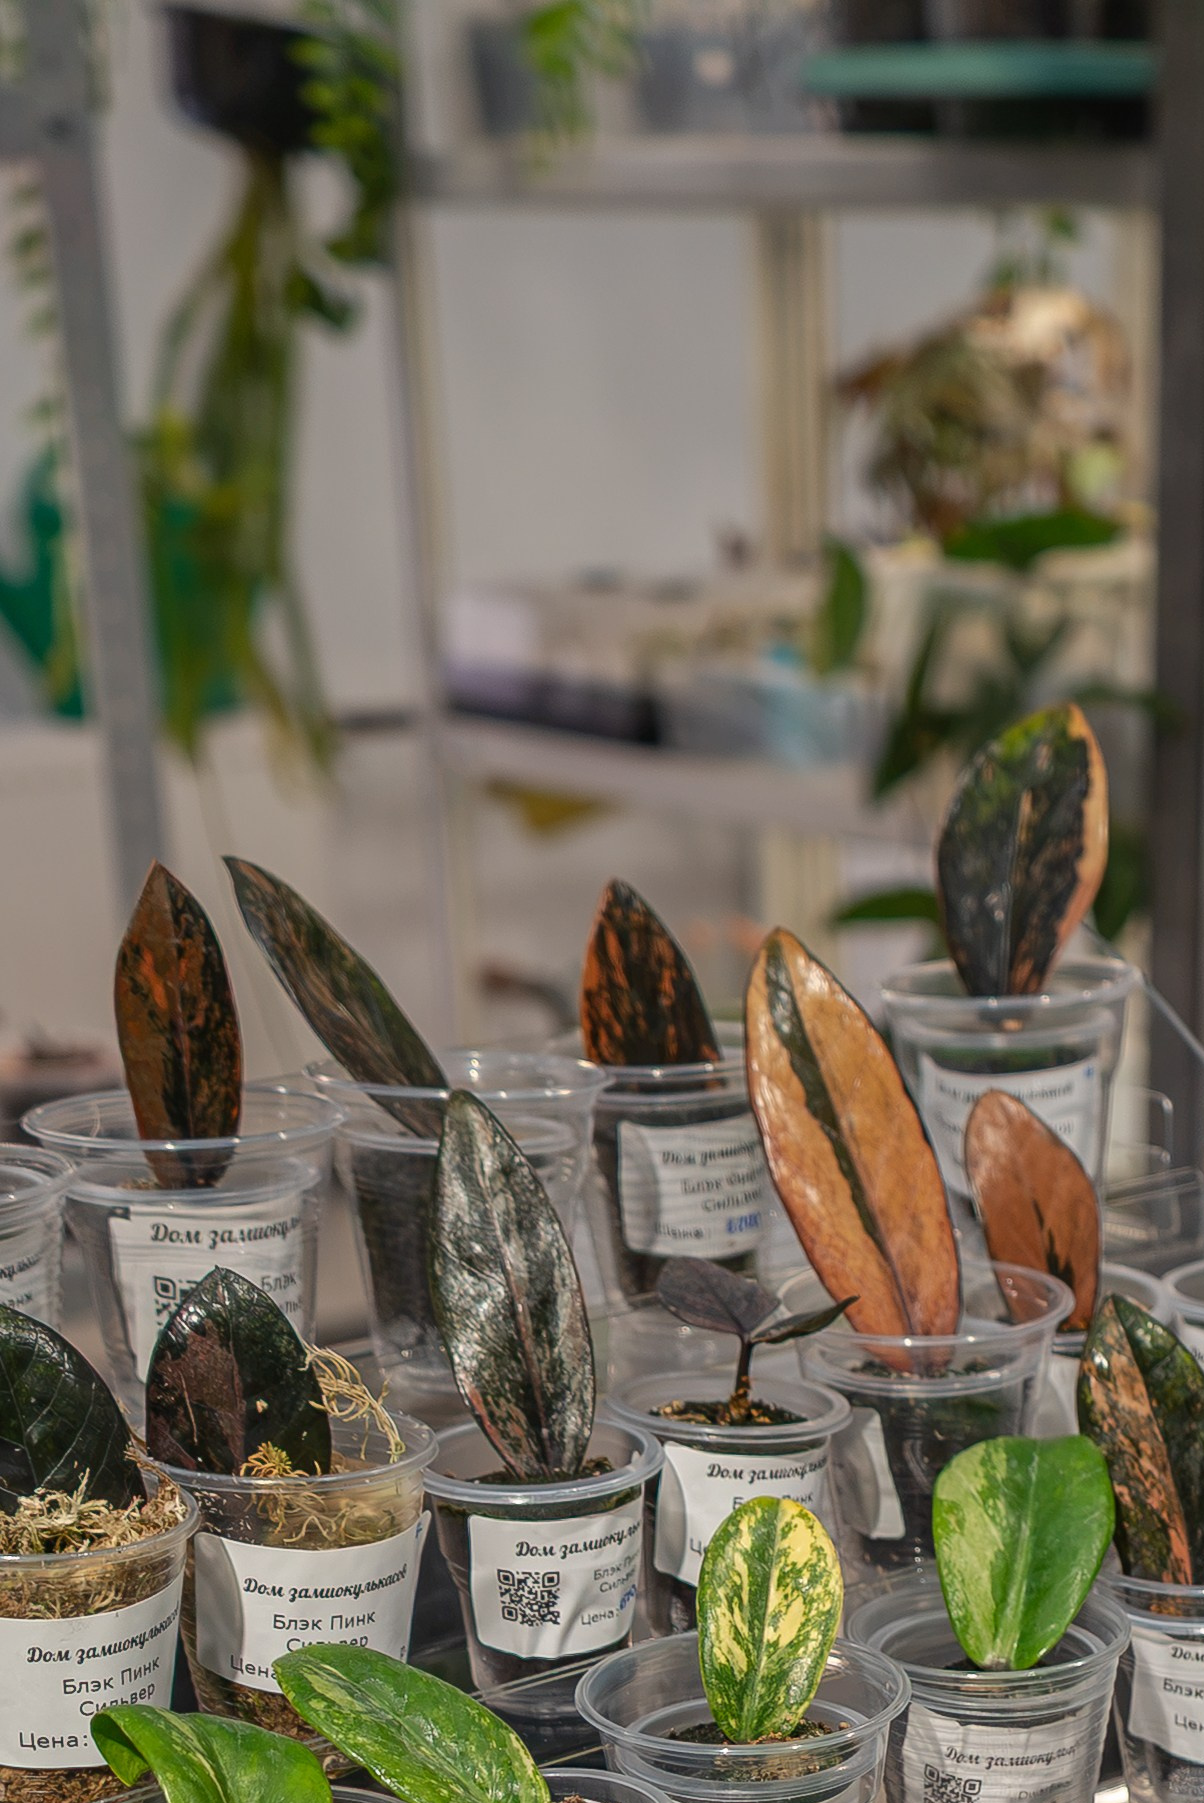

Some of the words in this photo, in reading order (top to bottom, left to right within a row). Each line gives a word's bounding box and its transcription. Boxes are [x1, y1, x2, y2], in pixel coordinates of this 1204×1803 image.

[151, 1223, 201, 1244] Дом
[707, 1463, 743, 1480] Дом
[516, 1541, 556, 1557] Дом
[243, 1577, 284, 1598] Дом
[273, 1613, 323, 1631] Блэк
[330, 1611, 376, 1631] Пинк
[26, 1646, 71, 1664] Дом
[62, 1677, 115, 1695] Блэк
[120, 1656, 161, 1686] Пинк
[1163, 1677, 1204, 1700] Блэк
[19, 1731, 89, 1751] Цена:
